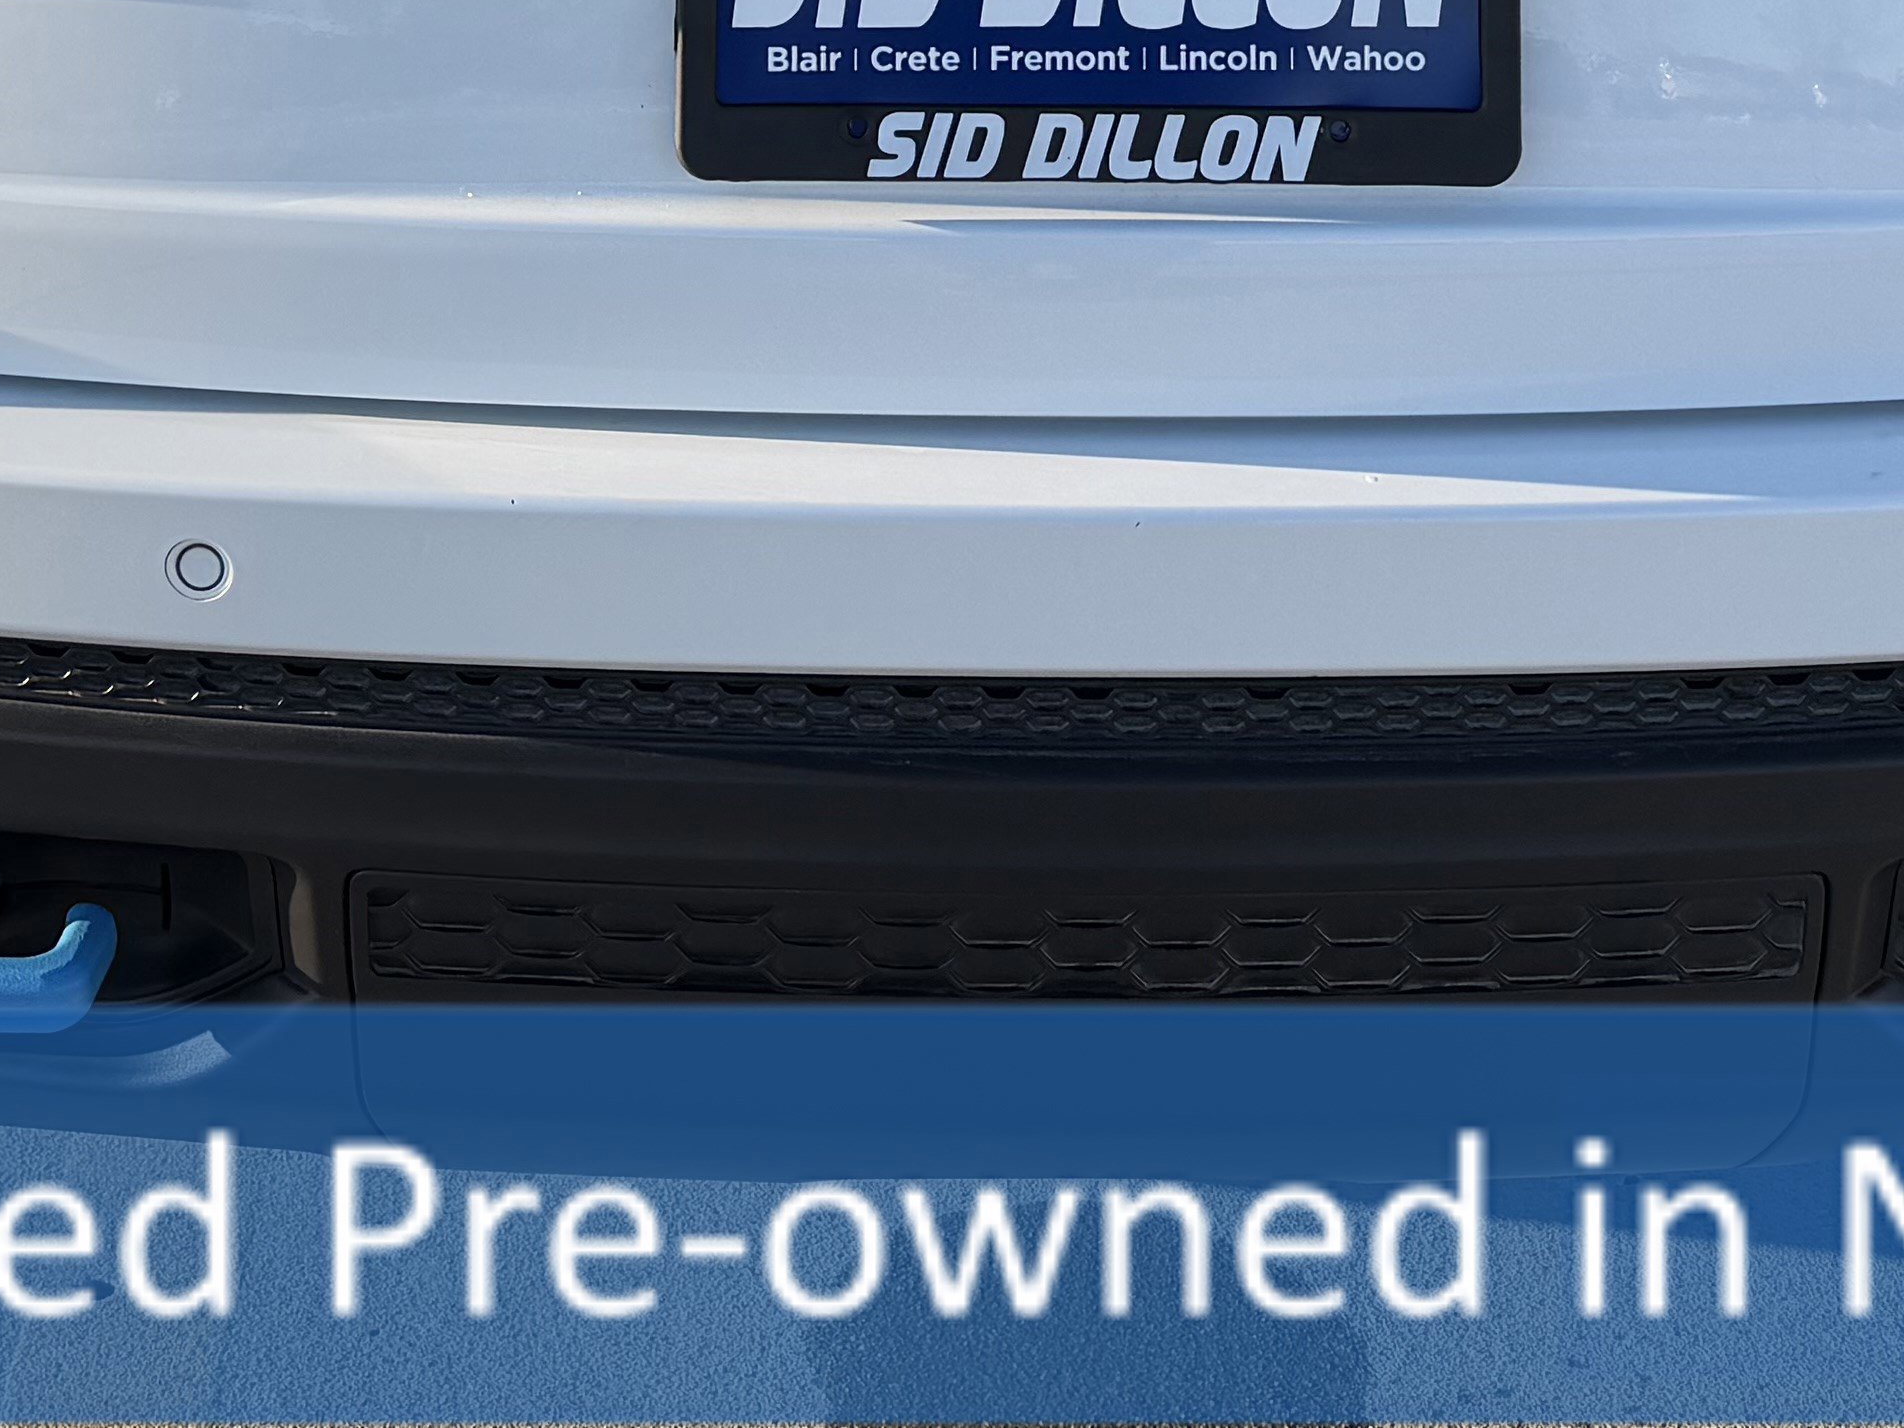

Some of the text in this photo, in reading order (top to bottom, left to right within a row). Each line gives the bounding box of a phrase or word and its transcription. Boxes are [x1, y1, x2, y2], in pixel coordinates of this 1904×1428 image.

[766, 44, 1427, 73] Blair Crete Fremont Lincoln Wahoo
[866, 112, 1324, 182] SID DILLON
